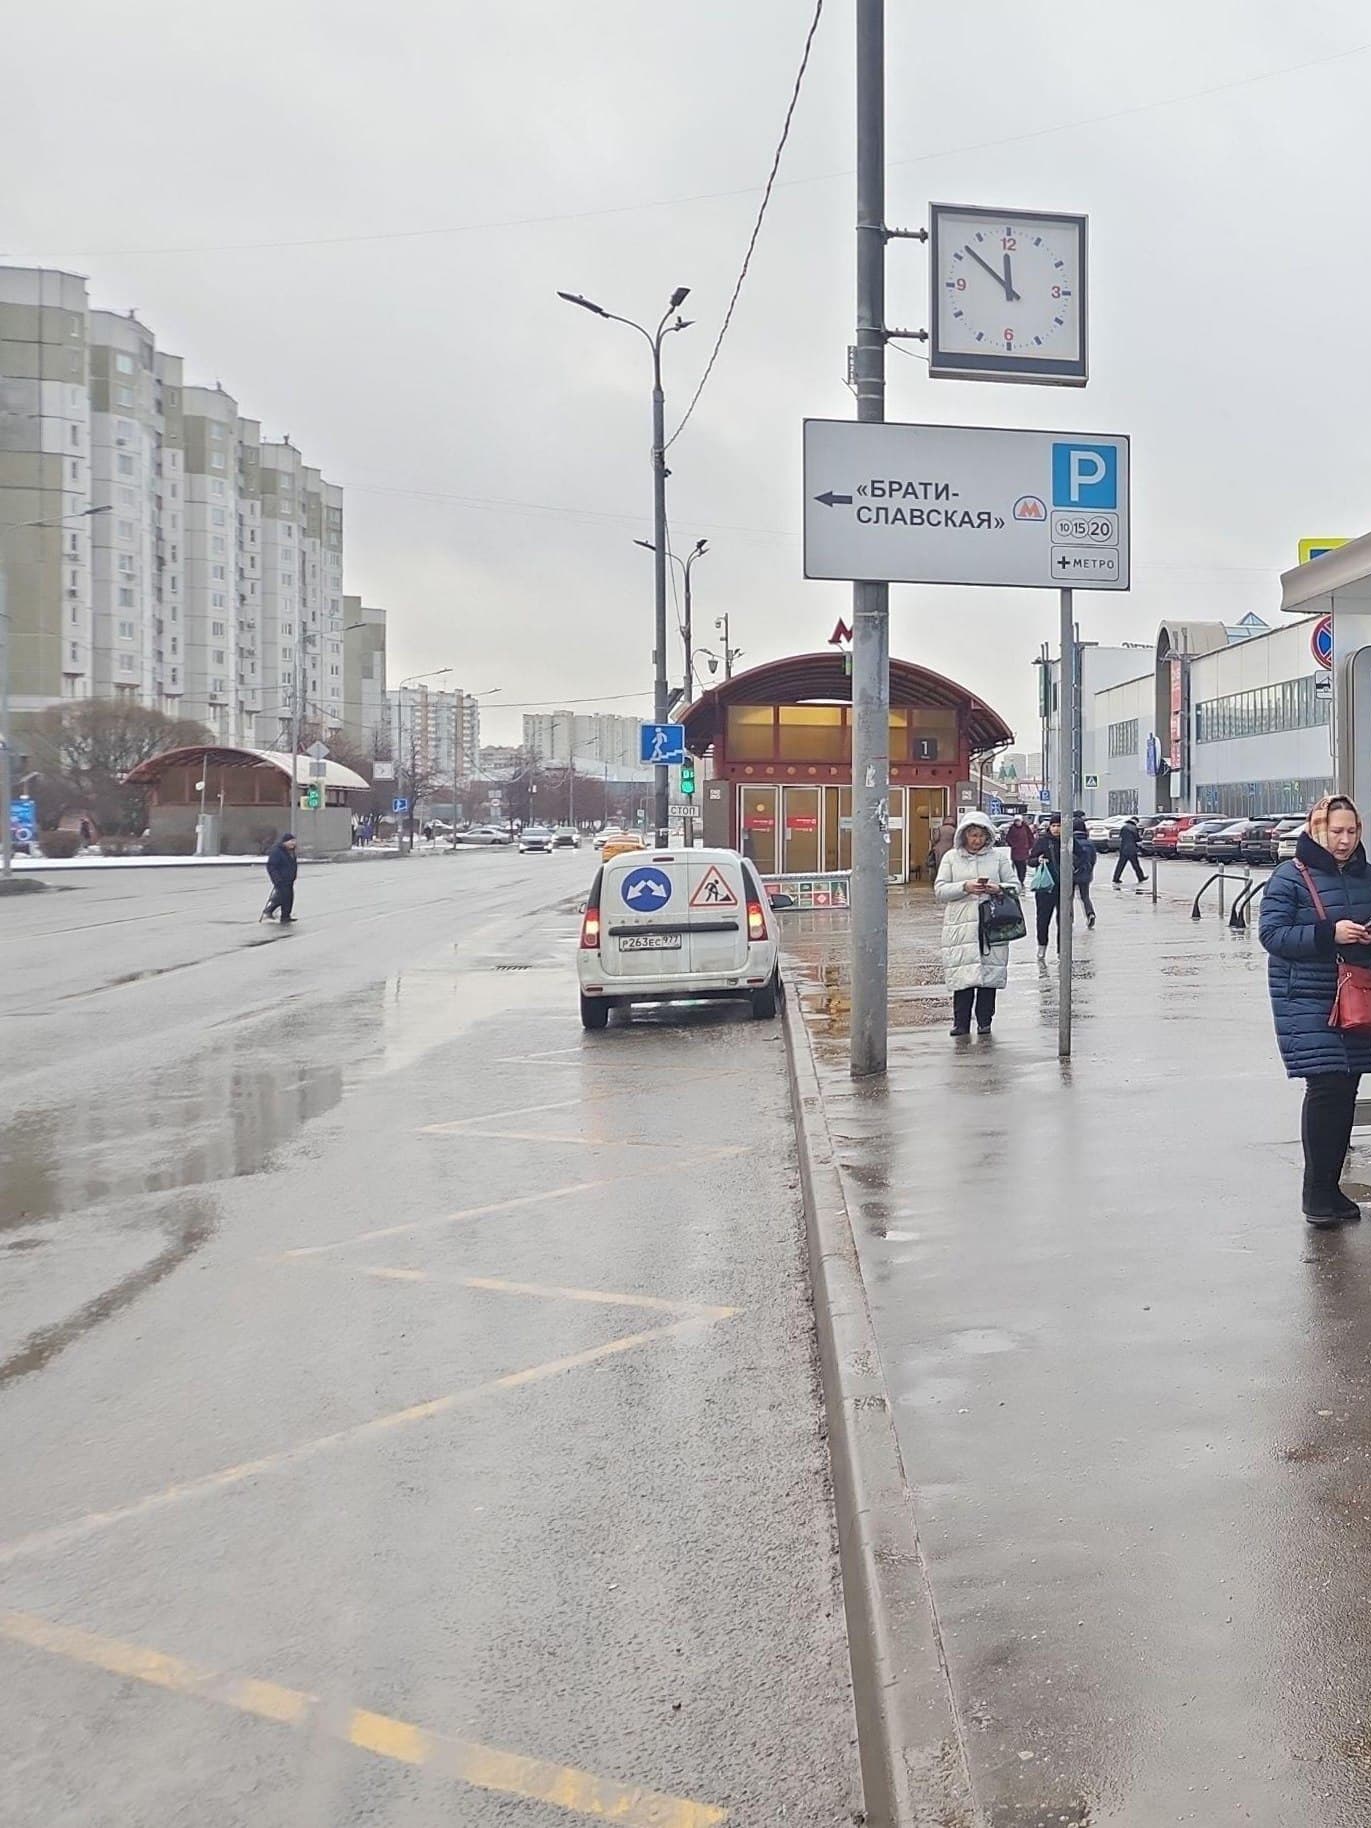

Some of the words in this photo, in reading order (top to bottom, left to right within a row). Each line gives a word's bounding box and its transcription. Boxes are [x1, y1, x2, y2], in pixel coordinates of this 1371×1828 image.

[1001, 238, 1017, 251] 12
[956, 278, 966, 291] 9
[1051, 286, 1061, 299] 3
[1003, 328, 1014, 341] 6
[1070, 449, 1106, 503] P
[856, 479, 959, 501] «БРАТИ-
[856, 505, 1005, 529] СЛАВСКАЯ»
[1059, 522, 1070, 532] 10
[1074, 522, 1086, 534] 15
[1090, 521, 1110, 536] 20
[921, 740, 928, 755] 1
[670, 806, 696, 815] СТОП
